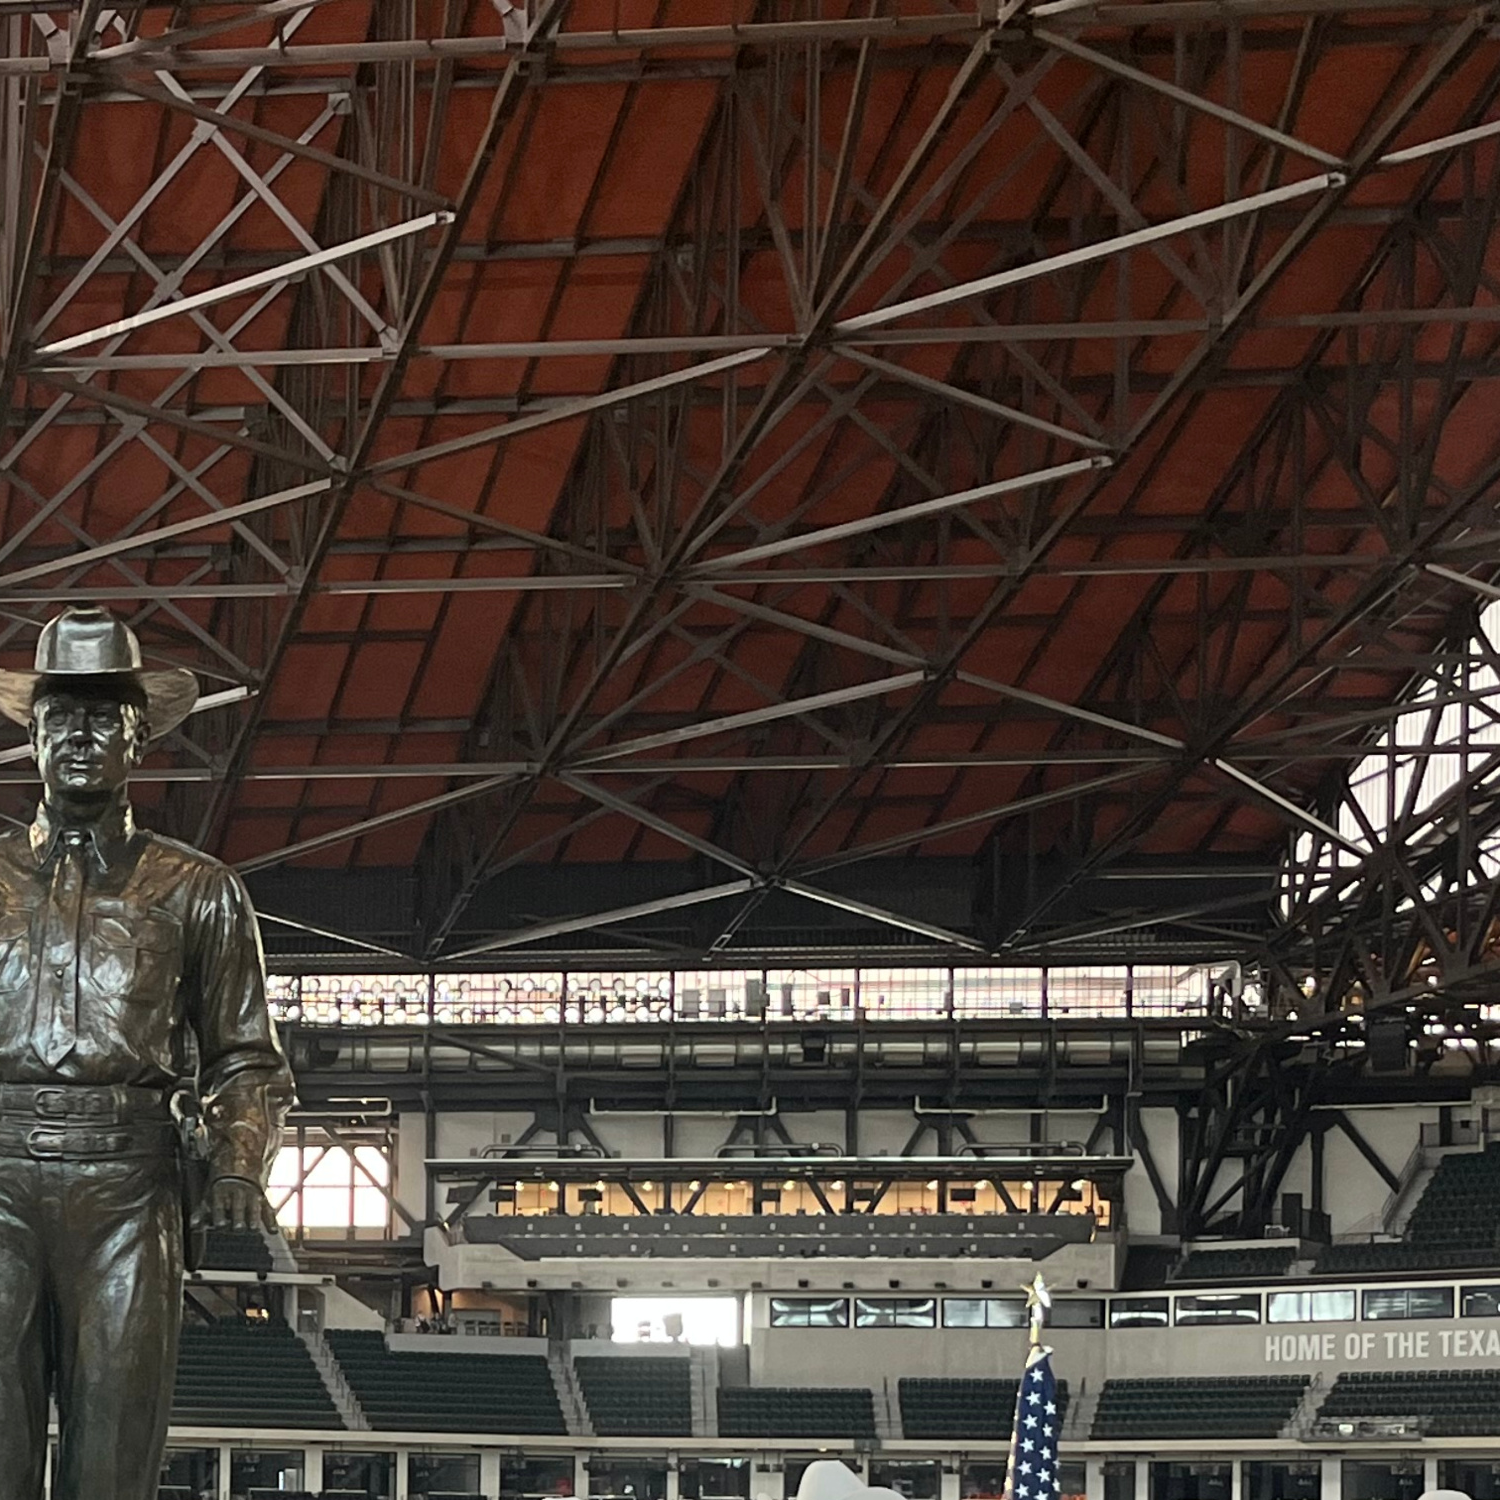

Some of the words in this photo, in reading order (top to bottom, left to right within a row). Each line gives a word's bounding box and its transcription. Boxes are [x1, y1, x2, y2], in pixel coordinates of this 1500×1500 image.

[1265, 1334, 1336, 1362] HOME
[1344, 1333, 1375, 1360] OF
[1384, 1331, 1429, 1359] THE
